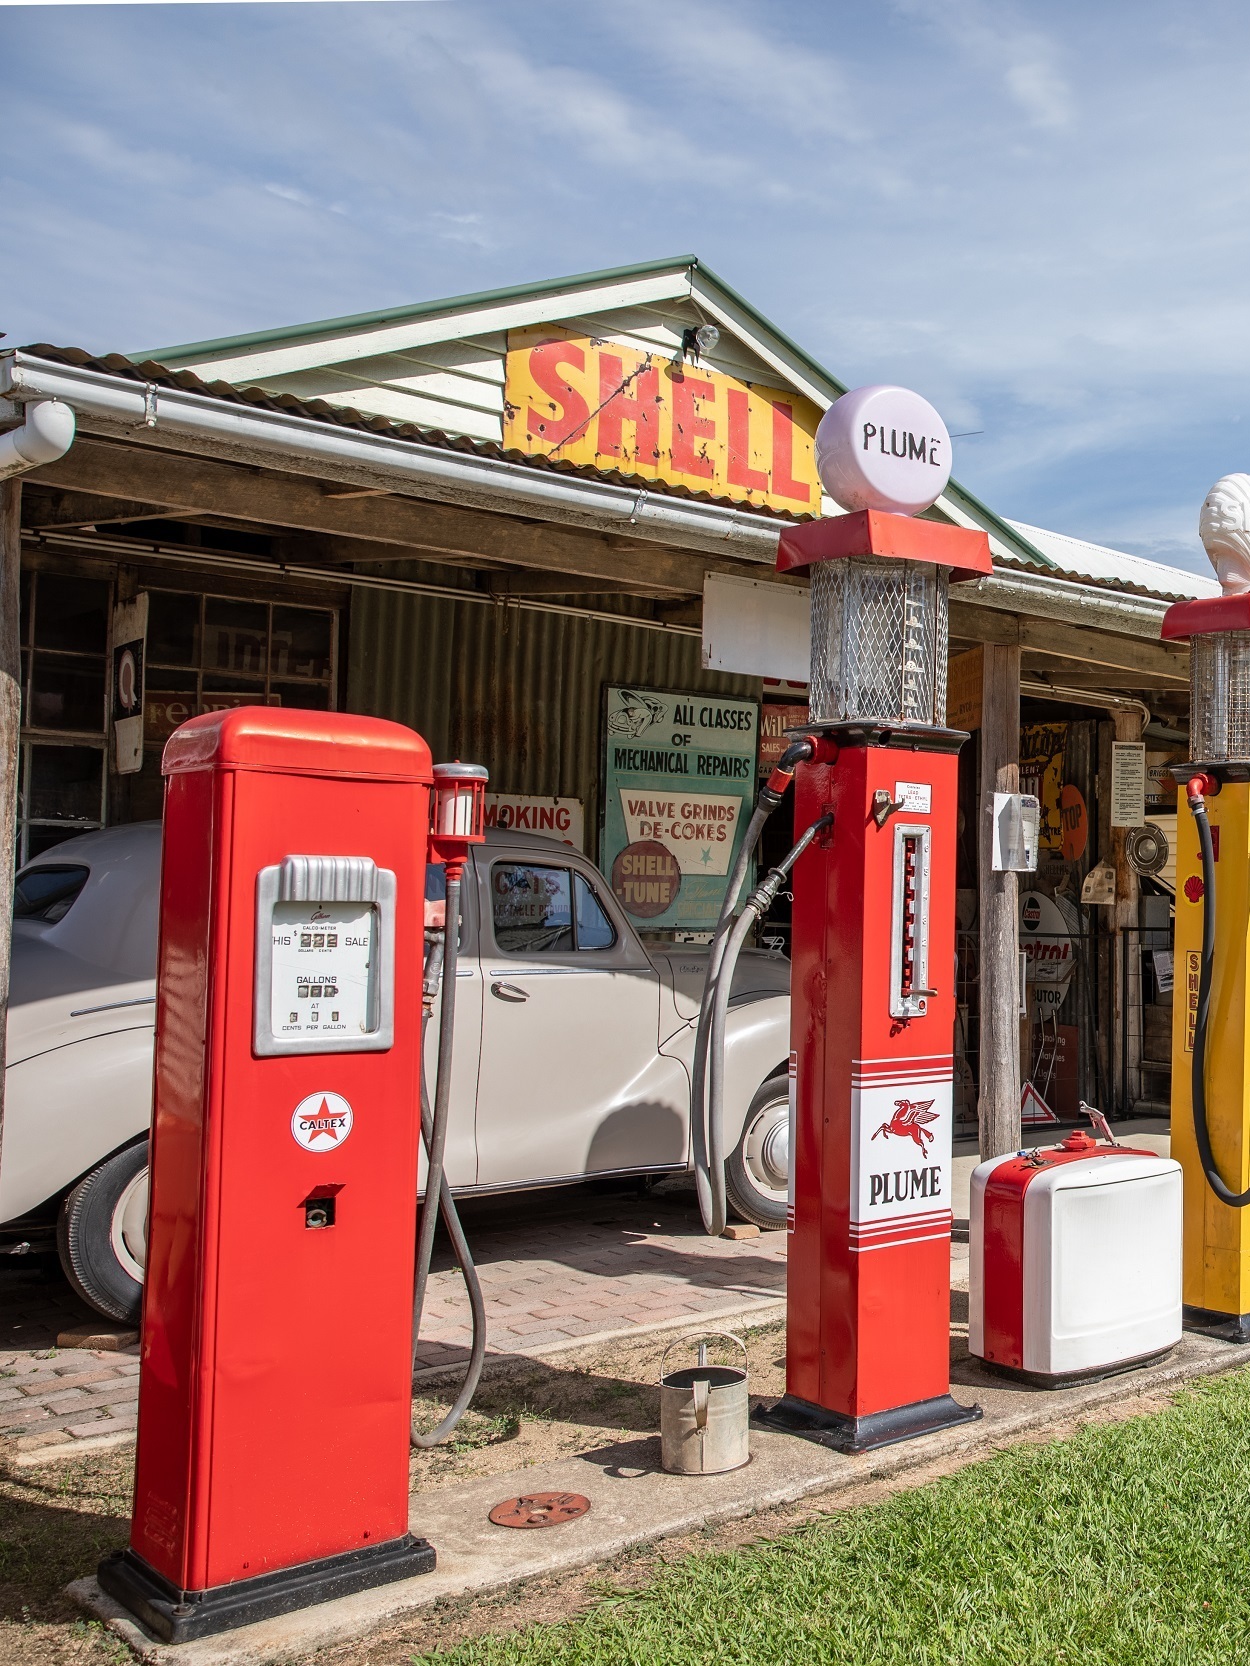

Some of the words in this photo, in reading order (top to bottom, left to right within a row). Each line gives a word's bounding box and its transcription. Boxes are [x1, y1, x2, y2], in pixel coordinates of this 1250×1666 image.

[526, 337, 811, 502] SHELL
[862, 421, 942, 467] PLUME
[672, 704, 696, 726] ALL
[700, 706, 752, 731] CLASSES
[671, 732, 692, 747] OF
[761, 743, 781, 753] SALES
[614, 747, 689, 774] MECHANICAL
[696, 754, 751, 778] REPAIRS
[1149, 769, 1169, 777] BRIGGS
[627, 799, 676, 819] VALVE
[681, 802, 736, 822] GRINDS
[1144, 795, 1162, 804] SALES
[479, 803, 571, 831] MOKING
[1061, 803, 1082, 832] TOP
[639, 820, 727, 842] DE-COKES
[621, 854, 675, 877] SHELL
[272, 936, 291, 946] HIS
[344, 937, 369, 947] SALE
[1019, 940, 1070, 960] strol
[296, 976, 337, 984] GALLONS
[1188, 953, 1200, 1050] SHELL
[1038, 1033, 1066, 1046] Smokng
[299, 1117, 347, 1131] CALTEX
[868, 1165, 942, 1207] PLUME
